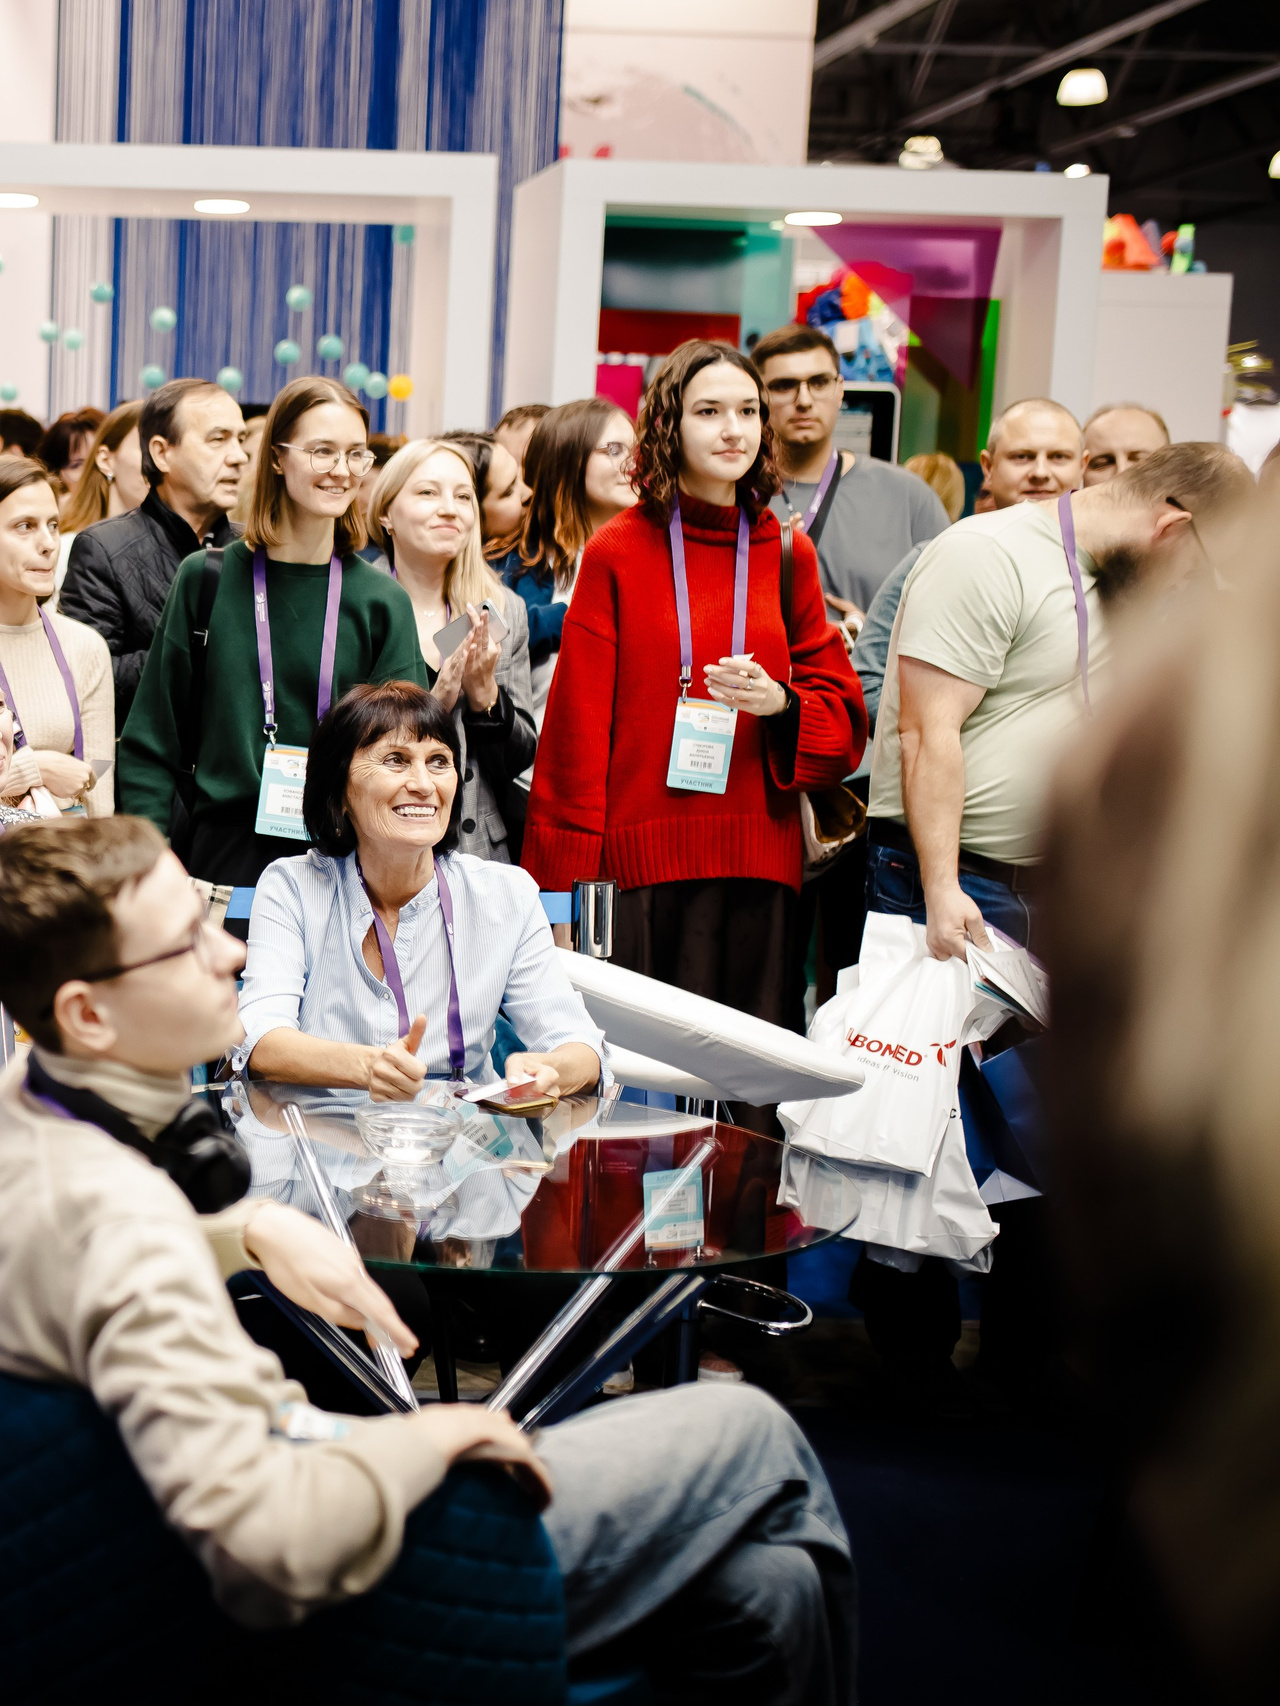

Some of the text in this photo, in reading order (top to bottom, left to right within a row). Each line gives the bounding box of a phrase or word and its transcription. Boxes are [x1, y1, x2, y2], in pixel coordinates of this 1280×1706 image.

[681, 778, 713, 789] УЧАСТНИК
[846, 1027, 923, 1066] LBOMED
[857, 1055, 880, 1069] ideas
[893, 1068, 920, 1082] vision
